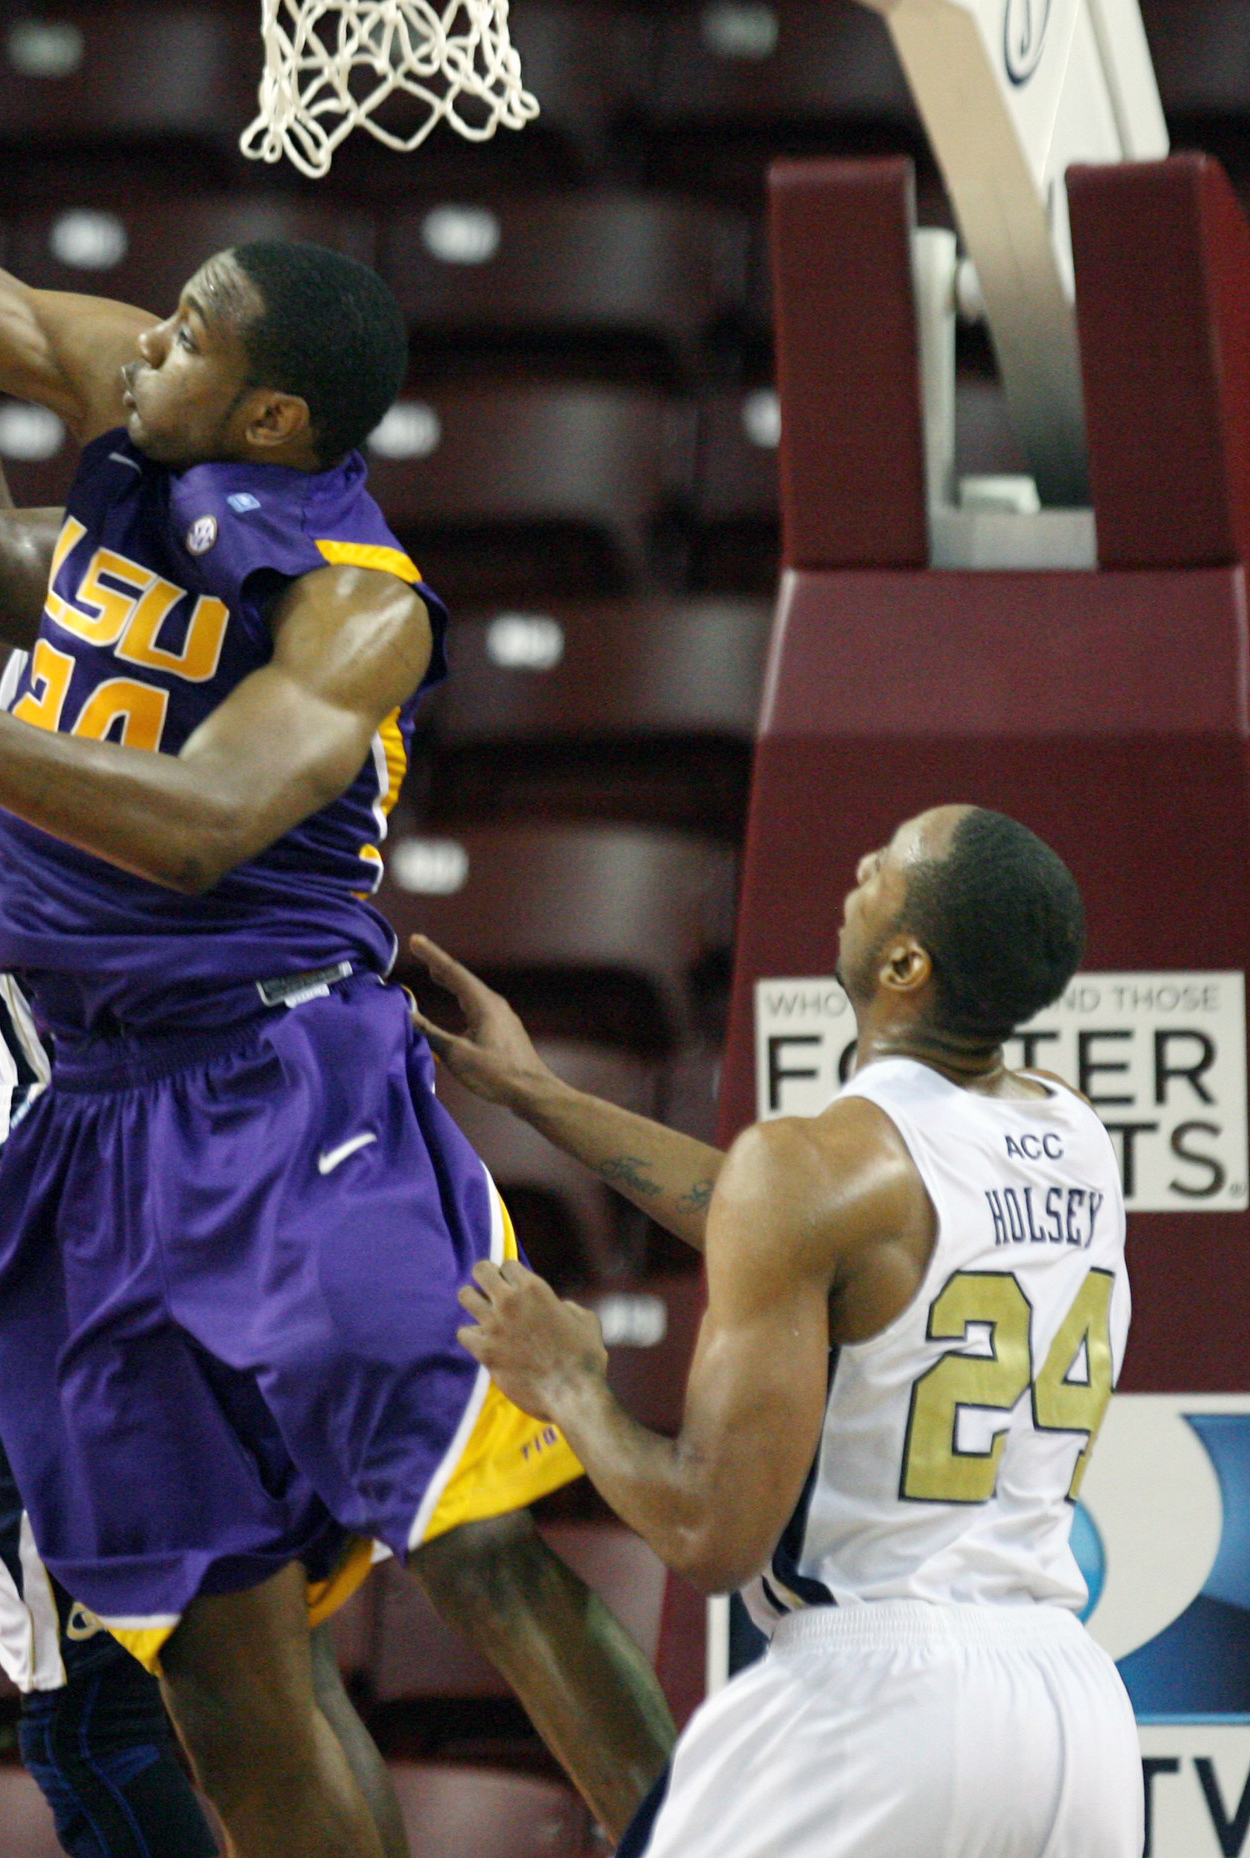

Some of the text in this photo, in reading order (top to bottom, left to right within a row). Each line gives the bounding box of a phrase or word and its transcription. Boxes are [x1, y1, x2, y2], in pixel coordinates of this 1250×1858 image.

[44, 514, 230, 683] LSU
[1113, 984, 1220, 1012] THOSE
[1004, 1133, 1065, 1160] ACC
[984, 1187, 1103, 1249] HOLSEY
[898, 1267, 1116, 1504] 24
